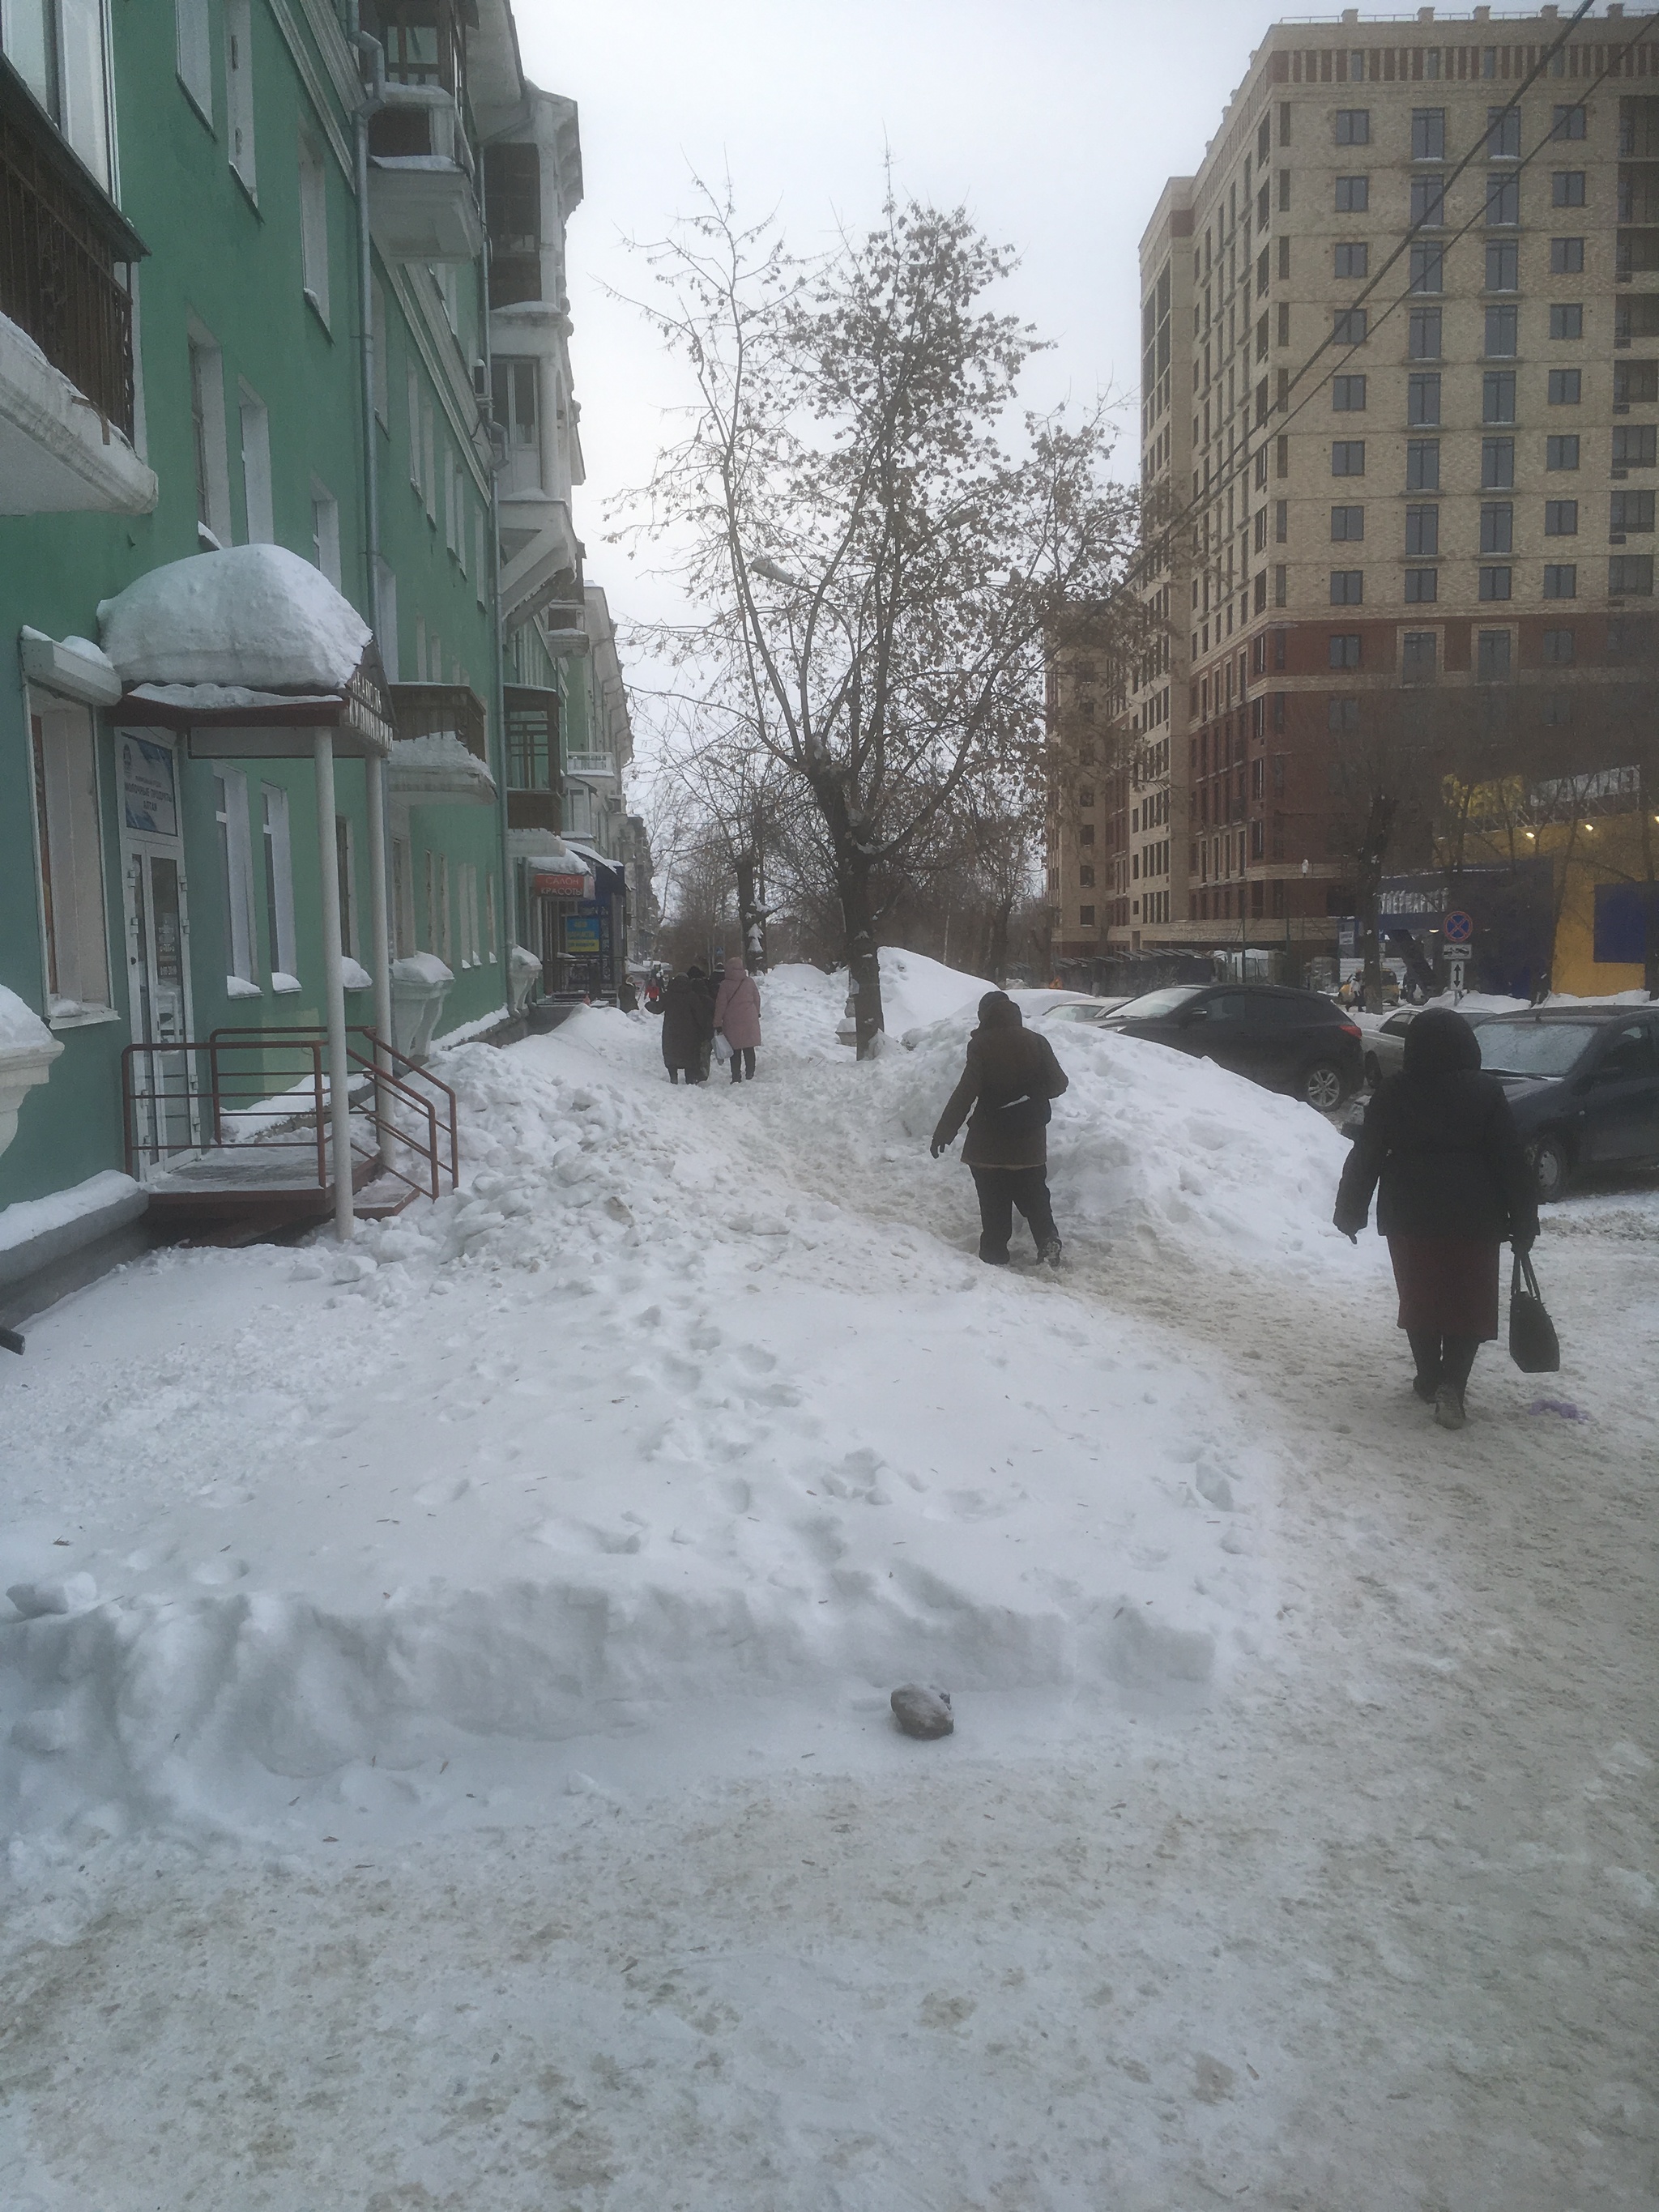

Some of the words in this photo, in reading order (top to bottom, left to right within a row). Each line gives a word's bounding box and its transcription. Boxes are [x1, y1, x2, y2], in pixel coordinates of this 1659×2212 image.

[349, 696, 394, 752] КУЛИНАРИЯ
[125, 782, 150, 797] МОЛОЧНЫЕ
[151, 789, 173, 803] ПРОДУКТЫ
[545, 876, 579, 885] САЛОН
[540, 887, 583, 896] КРАСОТЫ
